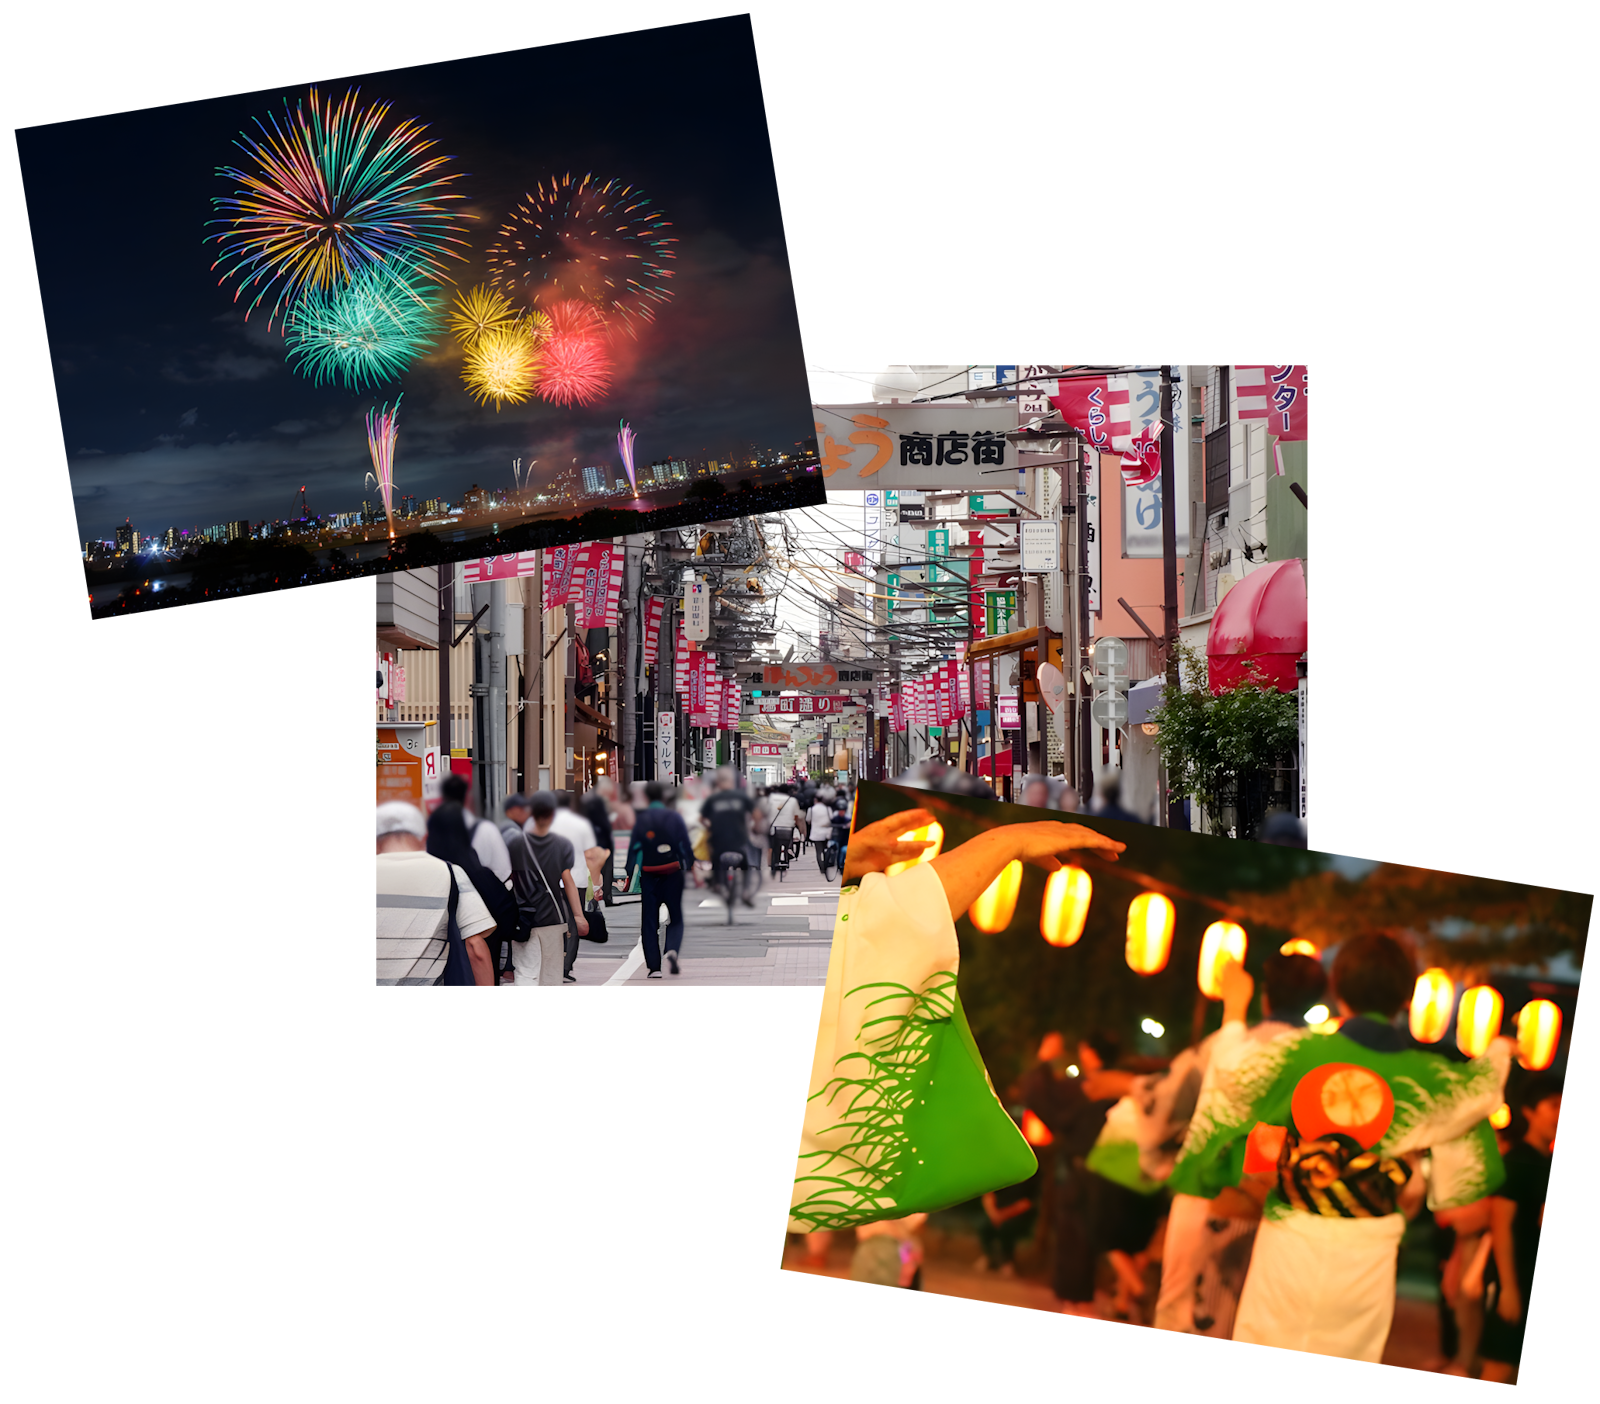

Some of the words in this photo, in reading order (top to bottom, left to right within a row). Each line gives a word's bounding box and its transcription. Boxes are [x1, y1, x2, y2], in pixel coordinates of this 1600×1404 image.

[815, 413, 1006, 482] ょう商店街
